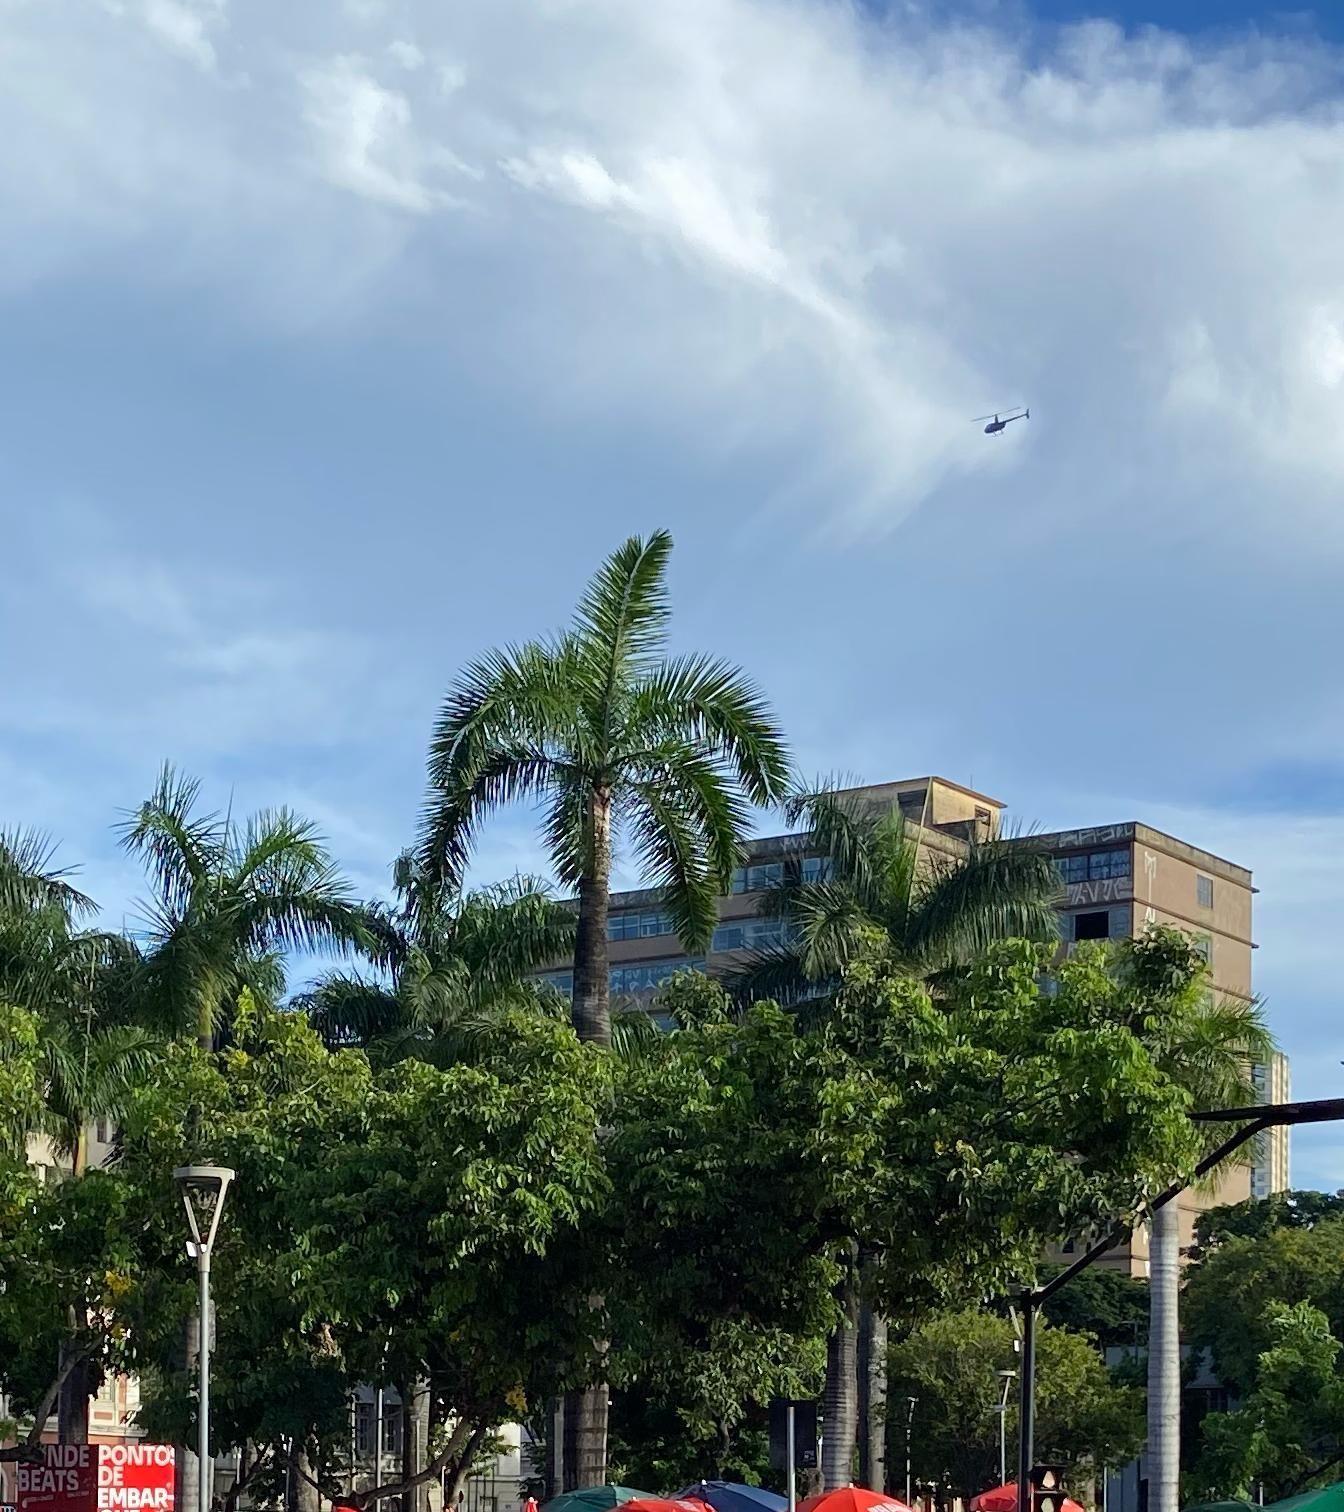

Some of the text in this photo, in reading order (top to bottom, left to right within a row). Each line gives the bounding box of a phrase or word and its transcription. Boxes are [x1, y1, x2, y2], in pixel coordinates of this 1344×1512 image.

[18, 1470, 78, 1492] BEATS
[98, 1466, 124, 1486] DE
[98, 1488, 174, 1508] EMBAR-
